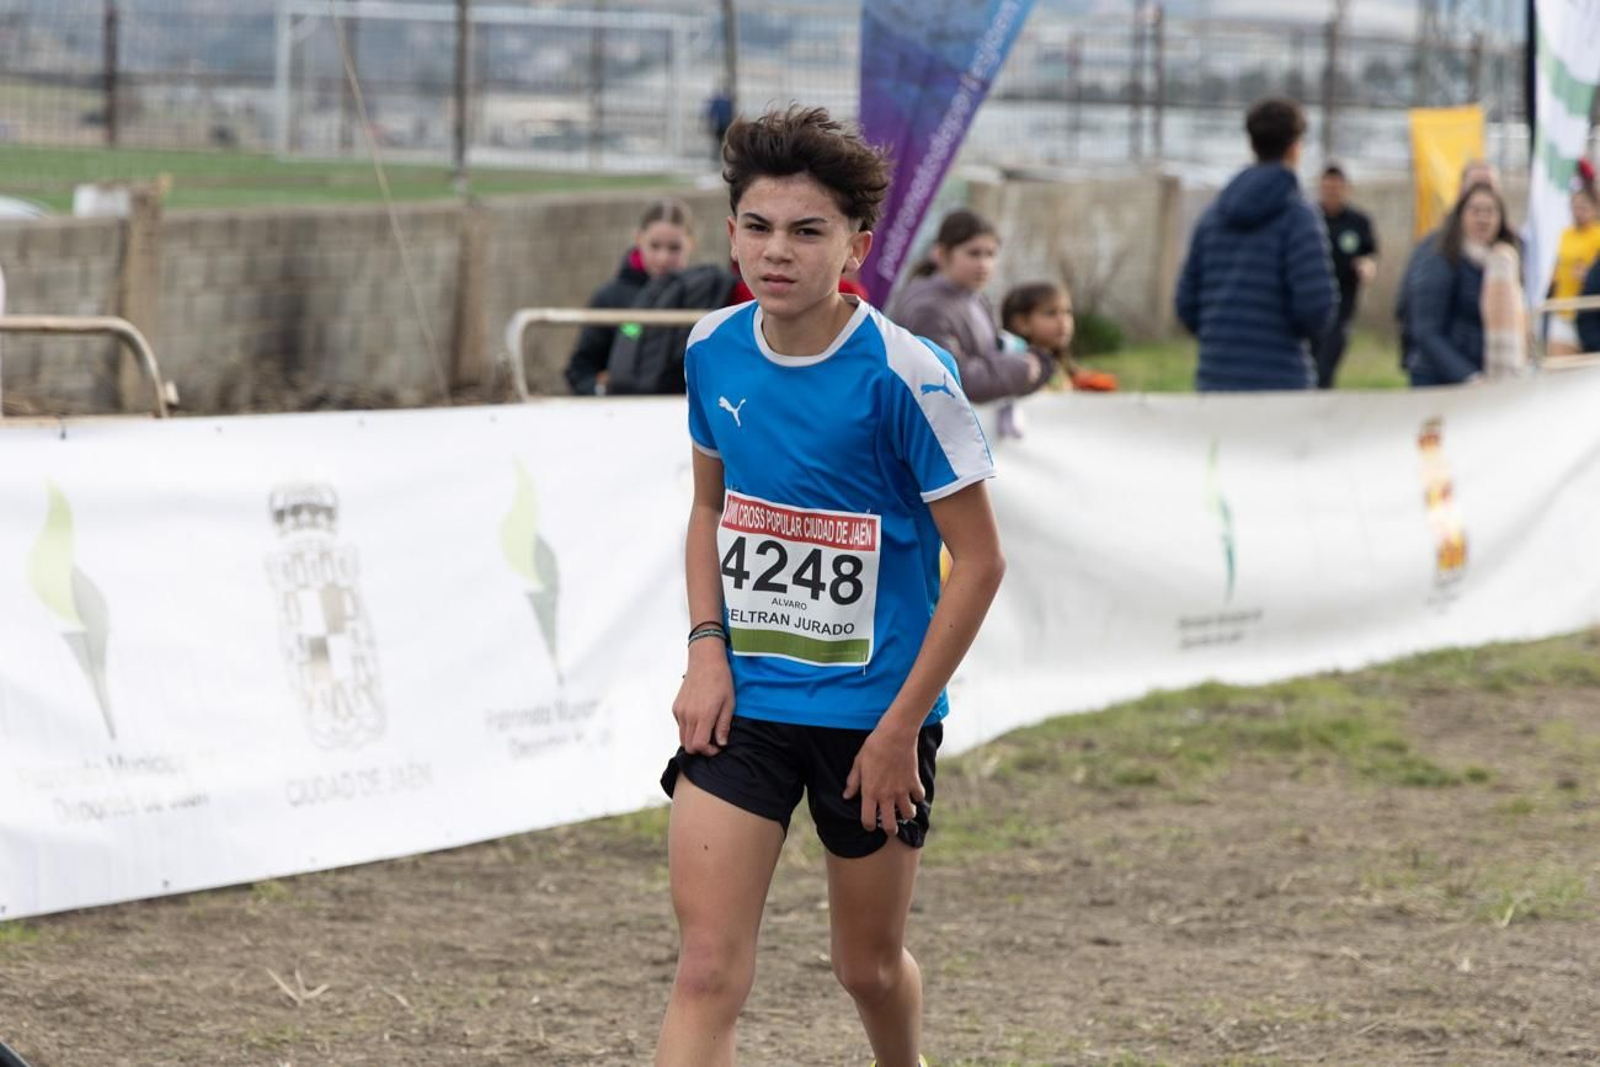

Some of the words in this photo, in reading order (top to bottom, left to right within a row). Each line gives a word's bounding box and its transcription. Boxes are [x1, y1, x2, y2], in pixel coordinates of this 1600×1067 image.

[738, 503, 765, 529] CROSS
[766, 509, 802, 538] POPULAR
[803, 517, 834, 542] CIUDAD
[836, 520, 848, 545] DE
[721, 536, 863, 606] 4248
[771, 597, 808, 611] ALVARO
[728, 608, 790, 626] ELTRAN
[794, 616, 855, 636] JURADO
